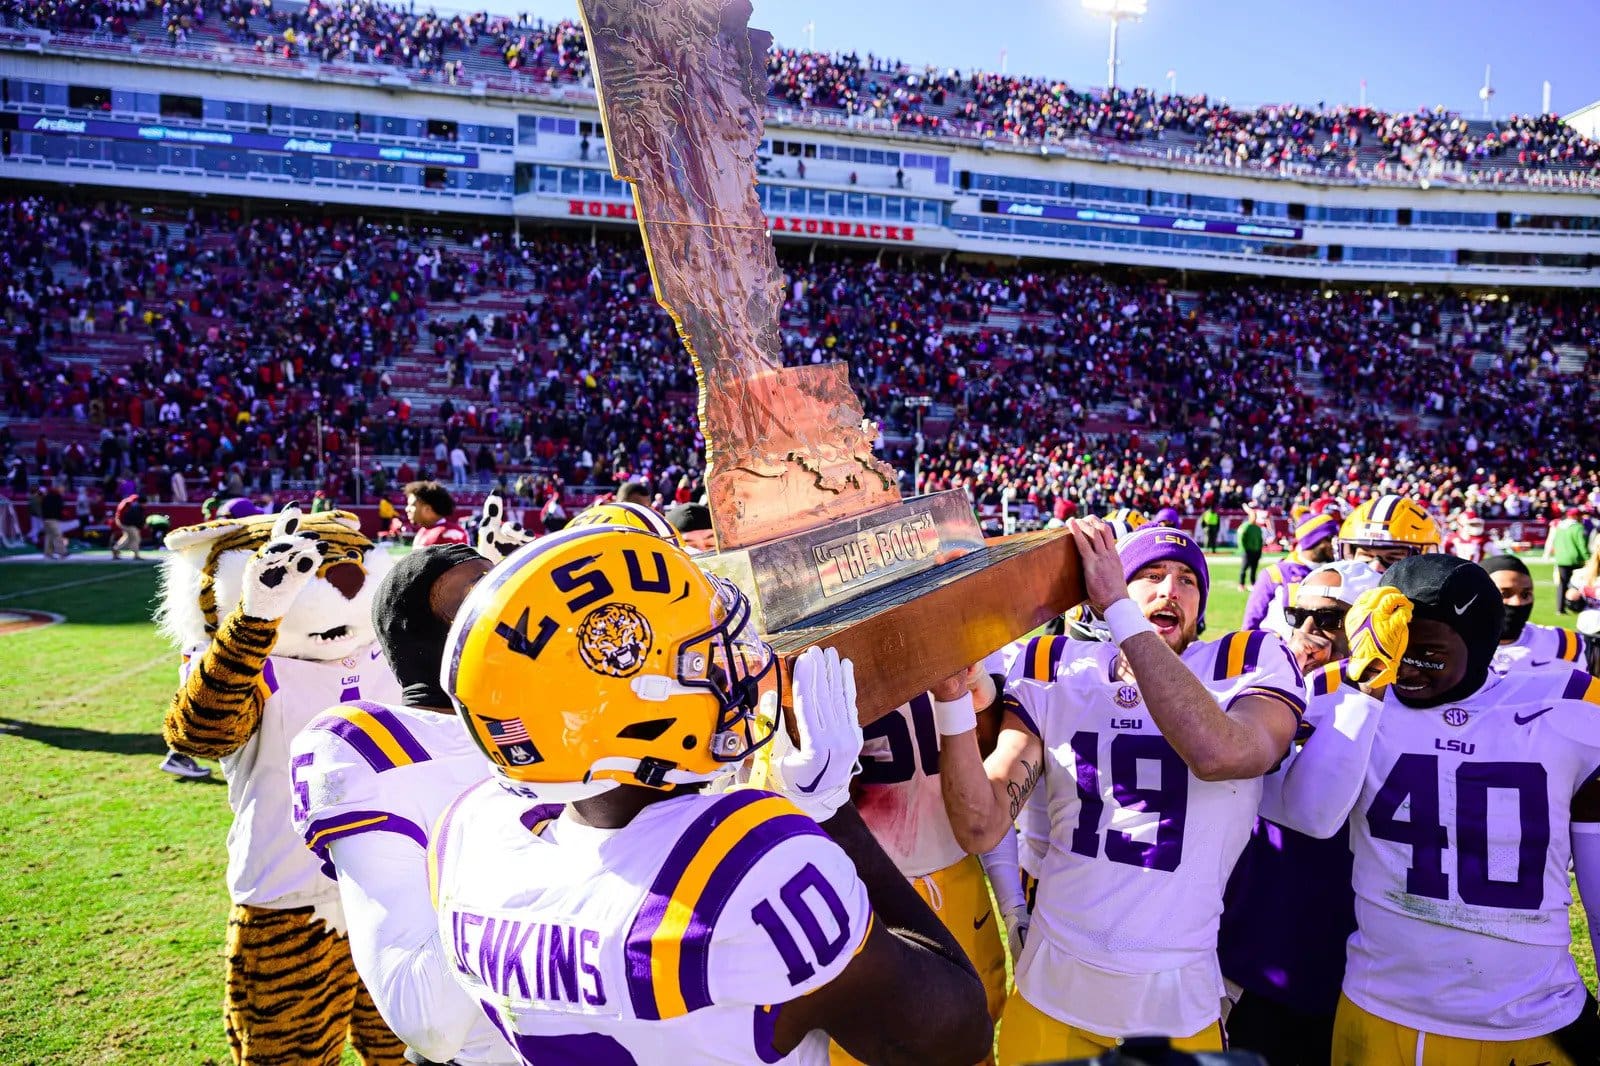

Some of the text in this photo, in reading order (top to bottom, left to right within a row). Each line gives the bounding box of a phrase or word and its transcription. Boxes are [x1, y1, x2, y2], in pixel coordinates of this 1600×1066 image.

[1155, 534, 1187, 547] LSU
[494, 549, 672, 660] LSU
[341, 674, 360, 686] LSU
[1110, 718, 1143, 729] LSU
[1434, 738, 1476, 755] LSU
[1070, 730, 1189, 873] 19
[1365, 752, 1551, 910] 40
[452, 910, 608, 1006] JENKINS
[751, 862, 851, 987] 10
